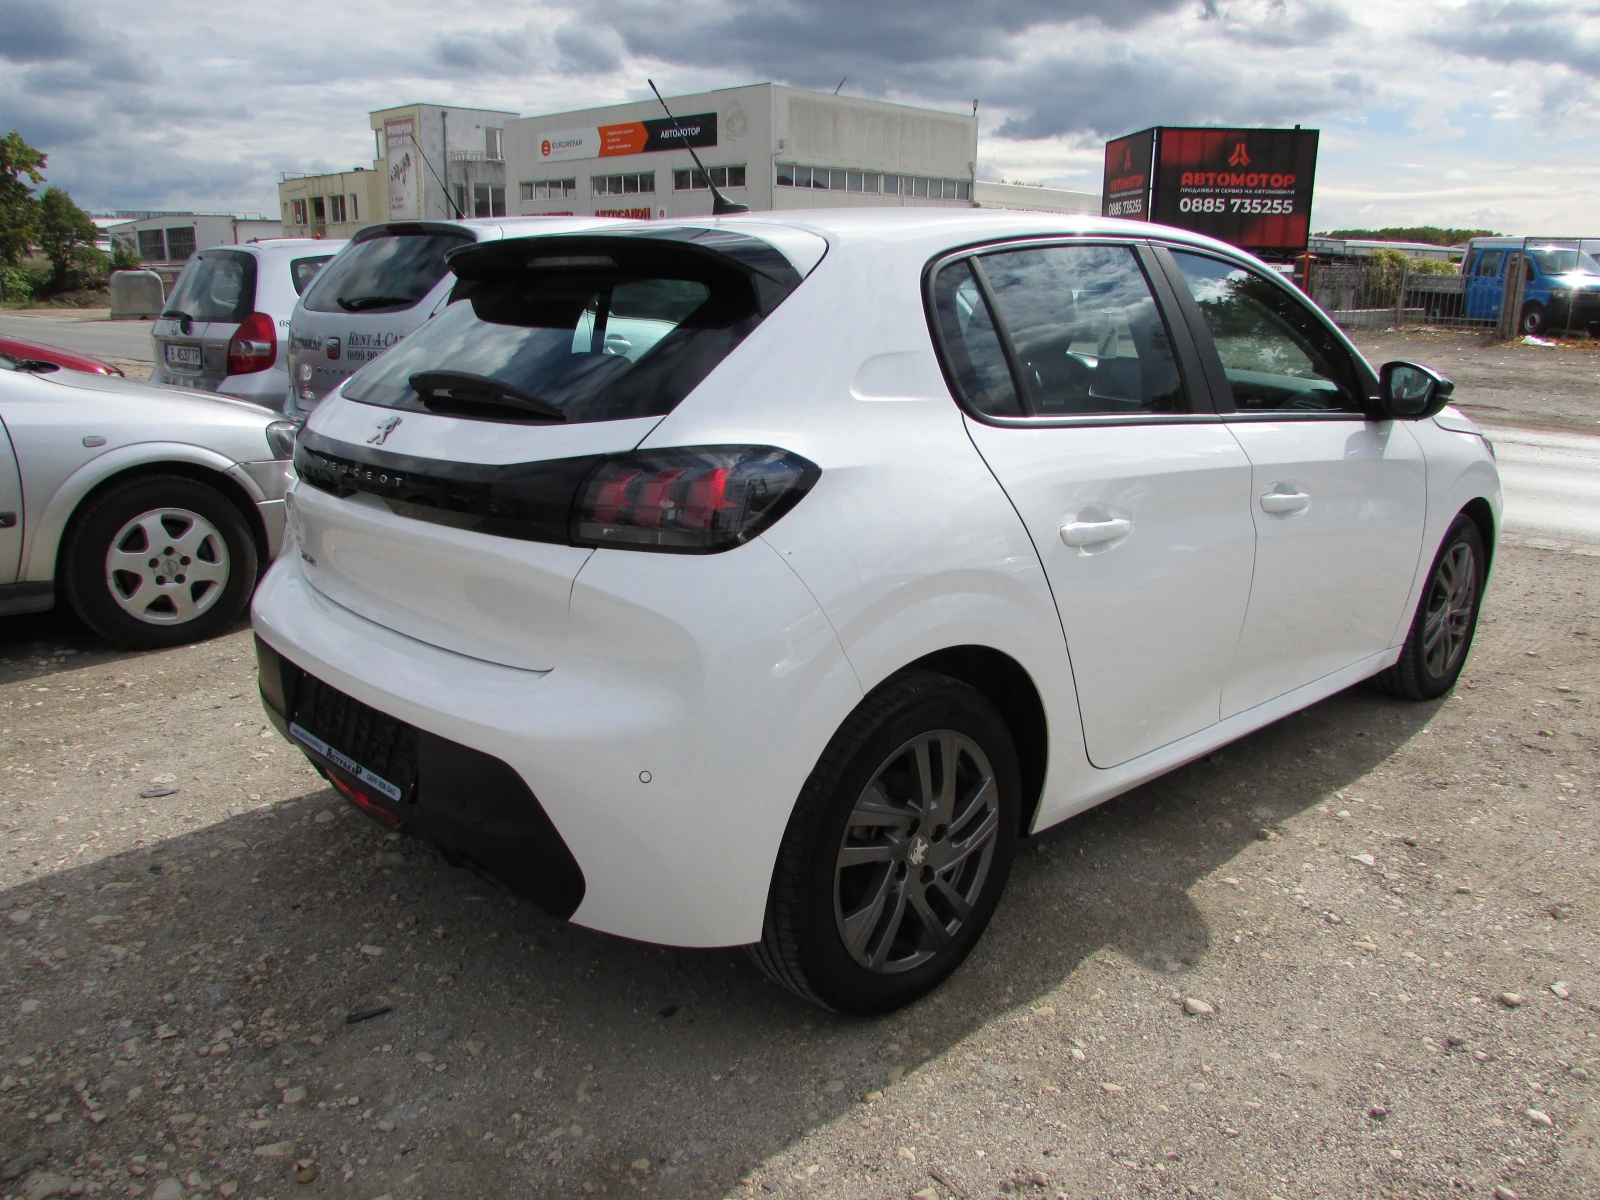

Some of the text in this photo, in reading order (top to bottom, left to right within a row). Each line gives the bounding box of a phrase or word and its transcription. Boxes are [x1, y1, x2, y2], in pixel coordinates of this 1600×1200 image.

[660, 126, 701, 139] АВТОМОТОР
[1181, 172, 1296, 187] АВТОМОТОР
[1108, 198, 1143, 217] 0885 735255
[1179, 197, 1294, 215] 0885 735255
[347, 349, 365, 361] 0899
[323, 459, 402, 487] PEUGEOT
